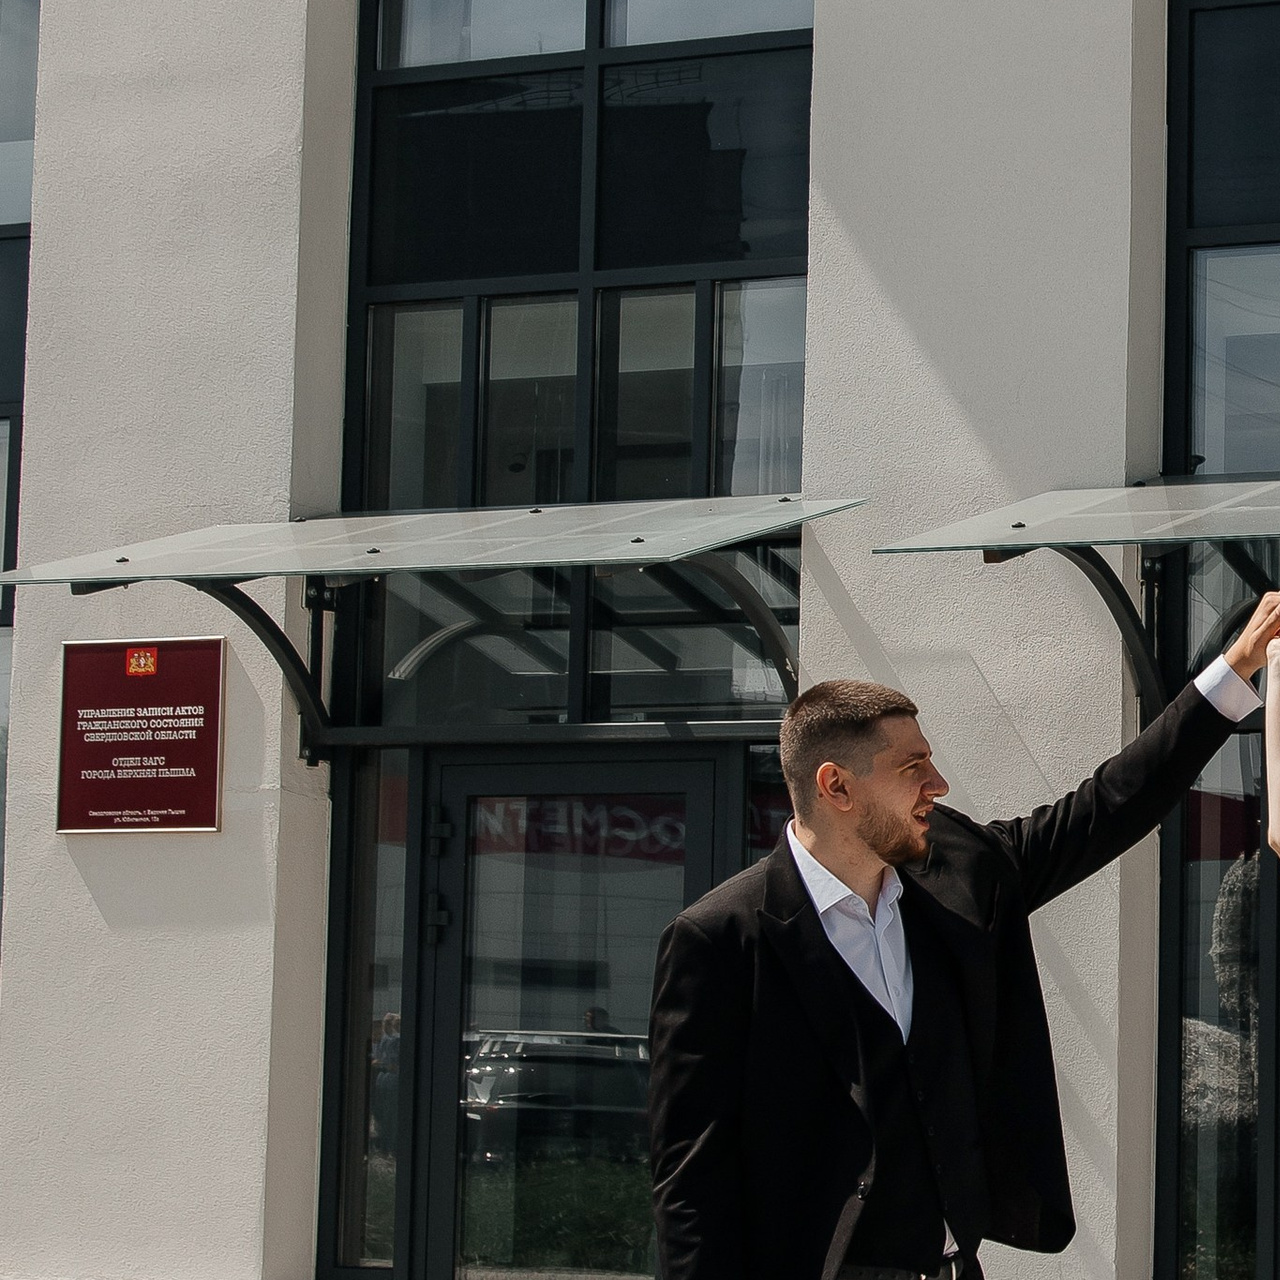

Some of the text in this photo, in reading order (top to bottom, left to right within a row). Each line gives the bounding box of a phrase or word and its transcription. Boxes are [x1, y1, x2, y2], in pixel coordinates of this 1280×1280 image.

[78, 706, 204, 718] УПРАВЛЕНИЕ ЗАПИСИ АКТОВ
[77, 718, 204, 730] ГРАЖДАНСКОГО СОСТОЯНИЯ
[84, 730, 196, 742] СВЕРДЛОВСКОЙ ОБЛАСТИ
[112, 757, 165, 767] ОТДЕЛ ЗАГС
[81, 768, 196, 779] ГОРОДА ВЕРХНЯЯ ПЫШМА
